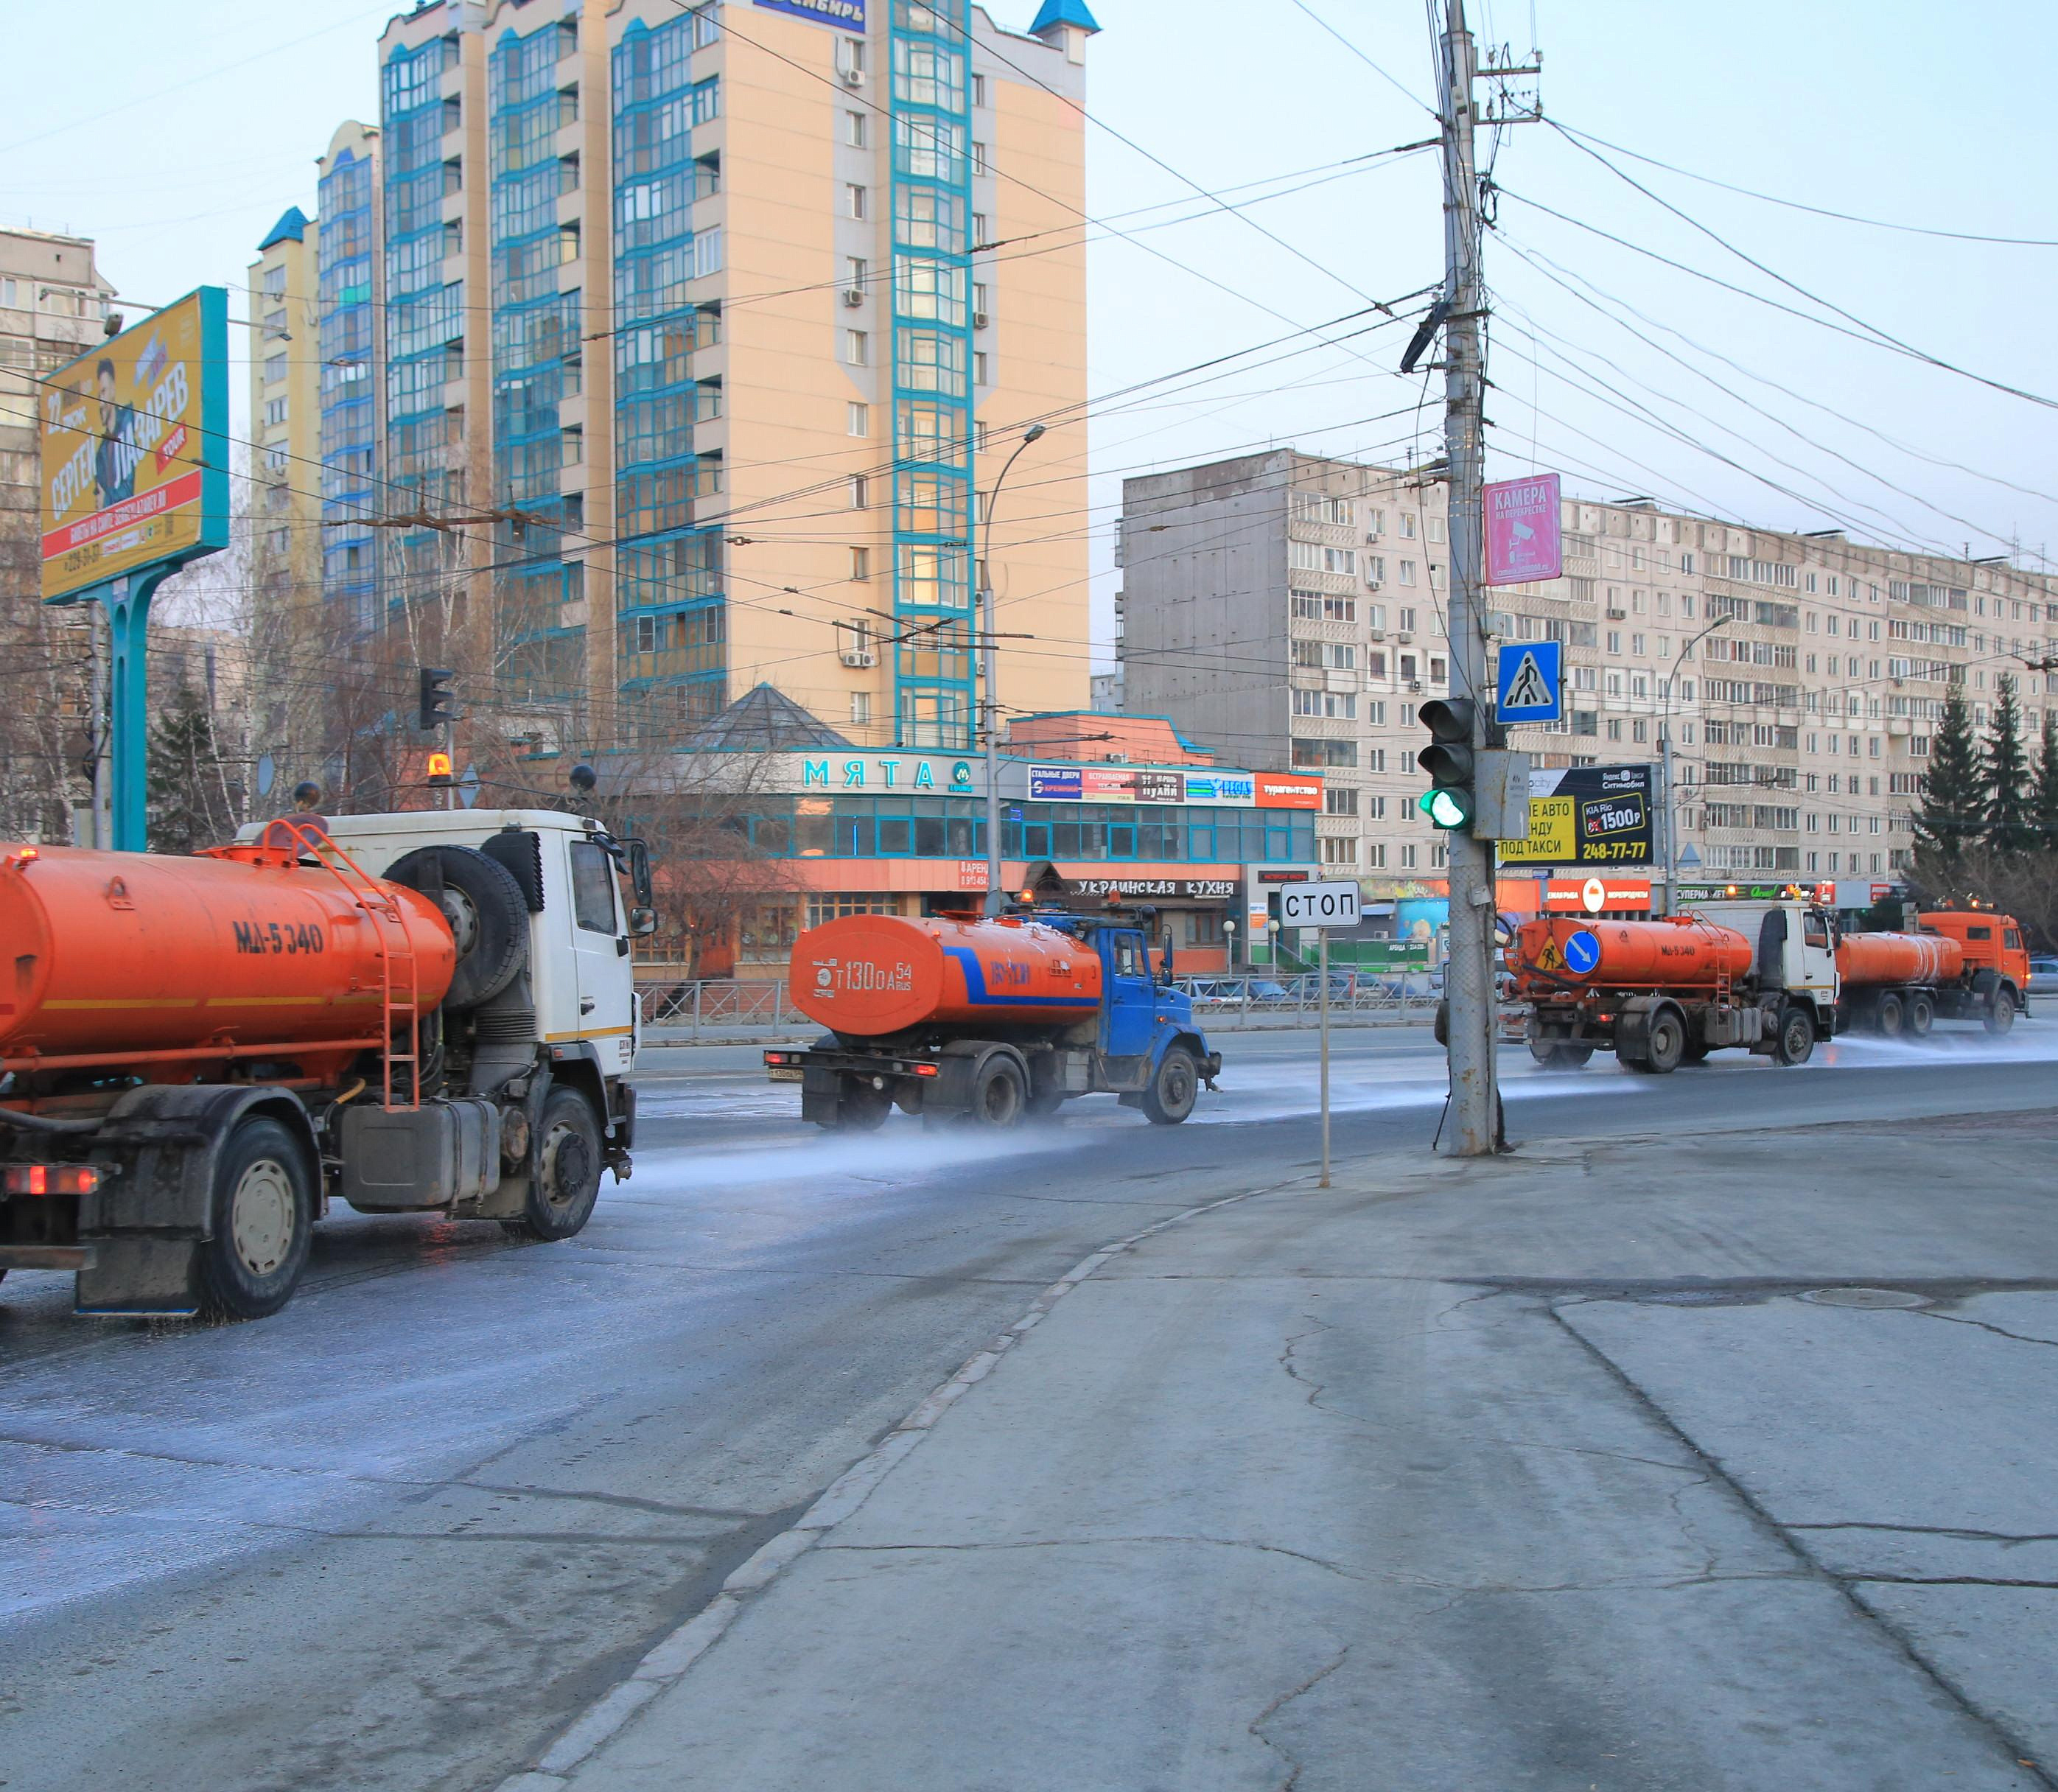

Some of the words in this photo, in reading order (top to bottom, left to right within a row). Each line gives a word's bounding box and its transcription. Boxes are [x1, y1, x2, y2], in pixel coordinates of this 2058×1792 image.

[114, 361, 189, 488] ЛАЗАРЕВ
[1495, 486, 1547, 511] КАМЕРА
[1496, 510, 1505, 519] НА
[802, 759, 935, 789] МЯТА
[1032, 769, 1061, 778] СТАЛЬНЫЕ
[1061, 771, 1080, 780] ДВЕРИ
[1603, 780, 1645, 789] Ситимобил
[1542, 802, 1569, 816] АВТО
[1586, 805, 1600, 816] KIA
[1600, 803, 1613, 812] Rio
[1529, 822, 1553, 836] НДУ
[1502, 841, 1525, 855] ПОД
[1527, 840, 1561, 854] ТАКСИ
[1583, 841, 1647, 860] 248-77-77
[1079, 880, 1176, 895] УКРАИНСКАЯ
[1186, 881, 1234, 895] КУХНЯ
[1286, 894, 1354, 917] СТОП
